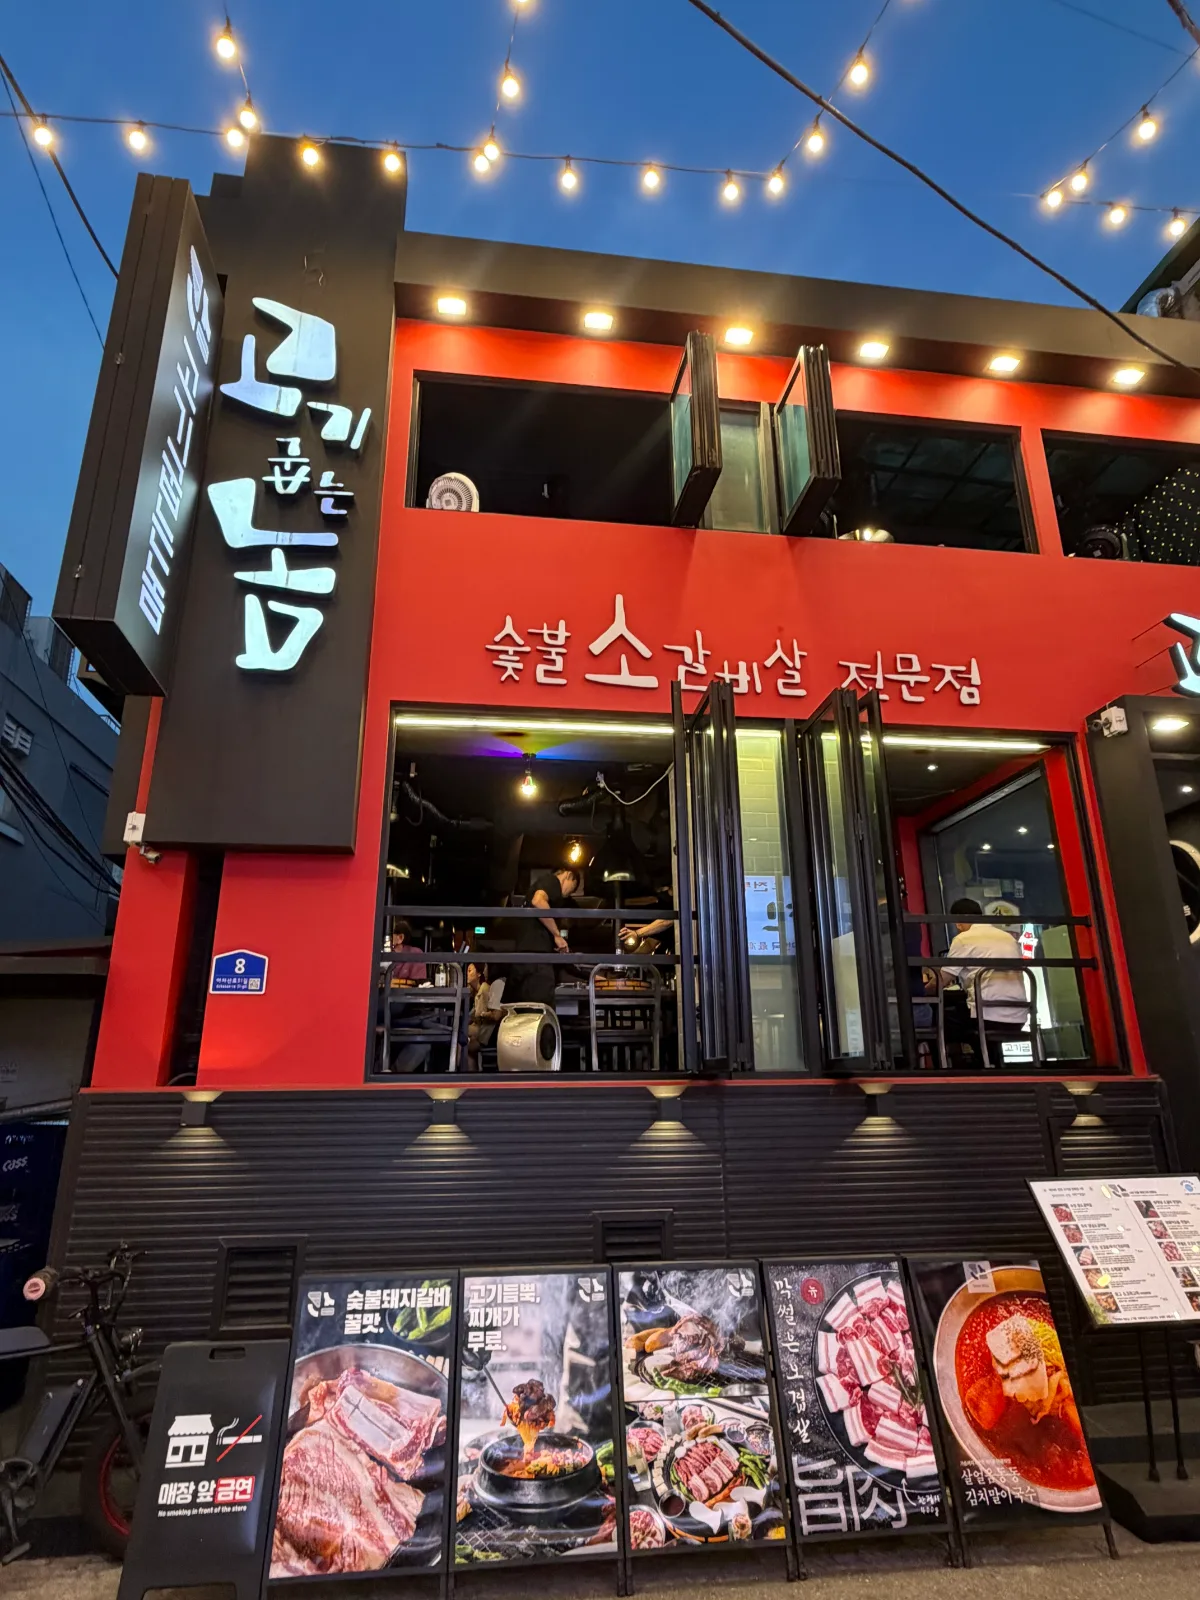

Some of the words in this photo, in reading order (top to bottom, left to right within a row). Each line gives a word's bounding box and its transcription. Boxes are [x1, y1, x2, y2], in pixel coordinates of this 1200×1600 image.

[485, 614, 572, 685] 숯불
[584, 593, 808, 697] 소갈비살
[838, 650, 982, 705] 전문점
[235, 958, 246, 974] 8
[346, 1287, 452, 1311] 숯불돼지갈비
[469, 1283, 541, 1304] 고기듬뿍,
[807, 1285, 819, 1299] 뉴
[344, 1312, 384, 1335] 꿀맛.
[467, 1306, 520, 1328] 찌개가
[467, 1330, 508, 1352] 무료.
[158, 1480, 196, 1505] 매장
[196, 1479, 217, 1503] 앞
[216, 1477, 253, 1502] 금연
[965, 1486, 1037, 1507] 김치말이국수
[166, 1508, 191, 1517] smoking
[191, 1507, 198, 1515] in
[198, 1505, 213, 1515] front
[214, 1505, 221, 1513] of
[221, 1504, 231, 1513] the
